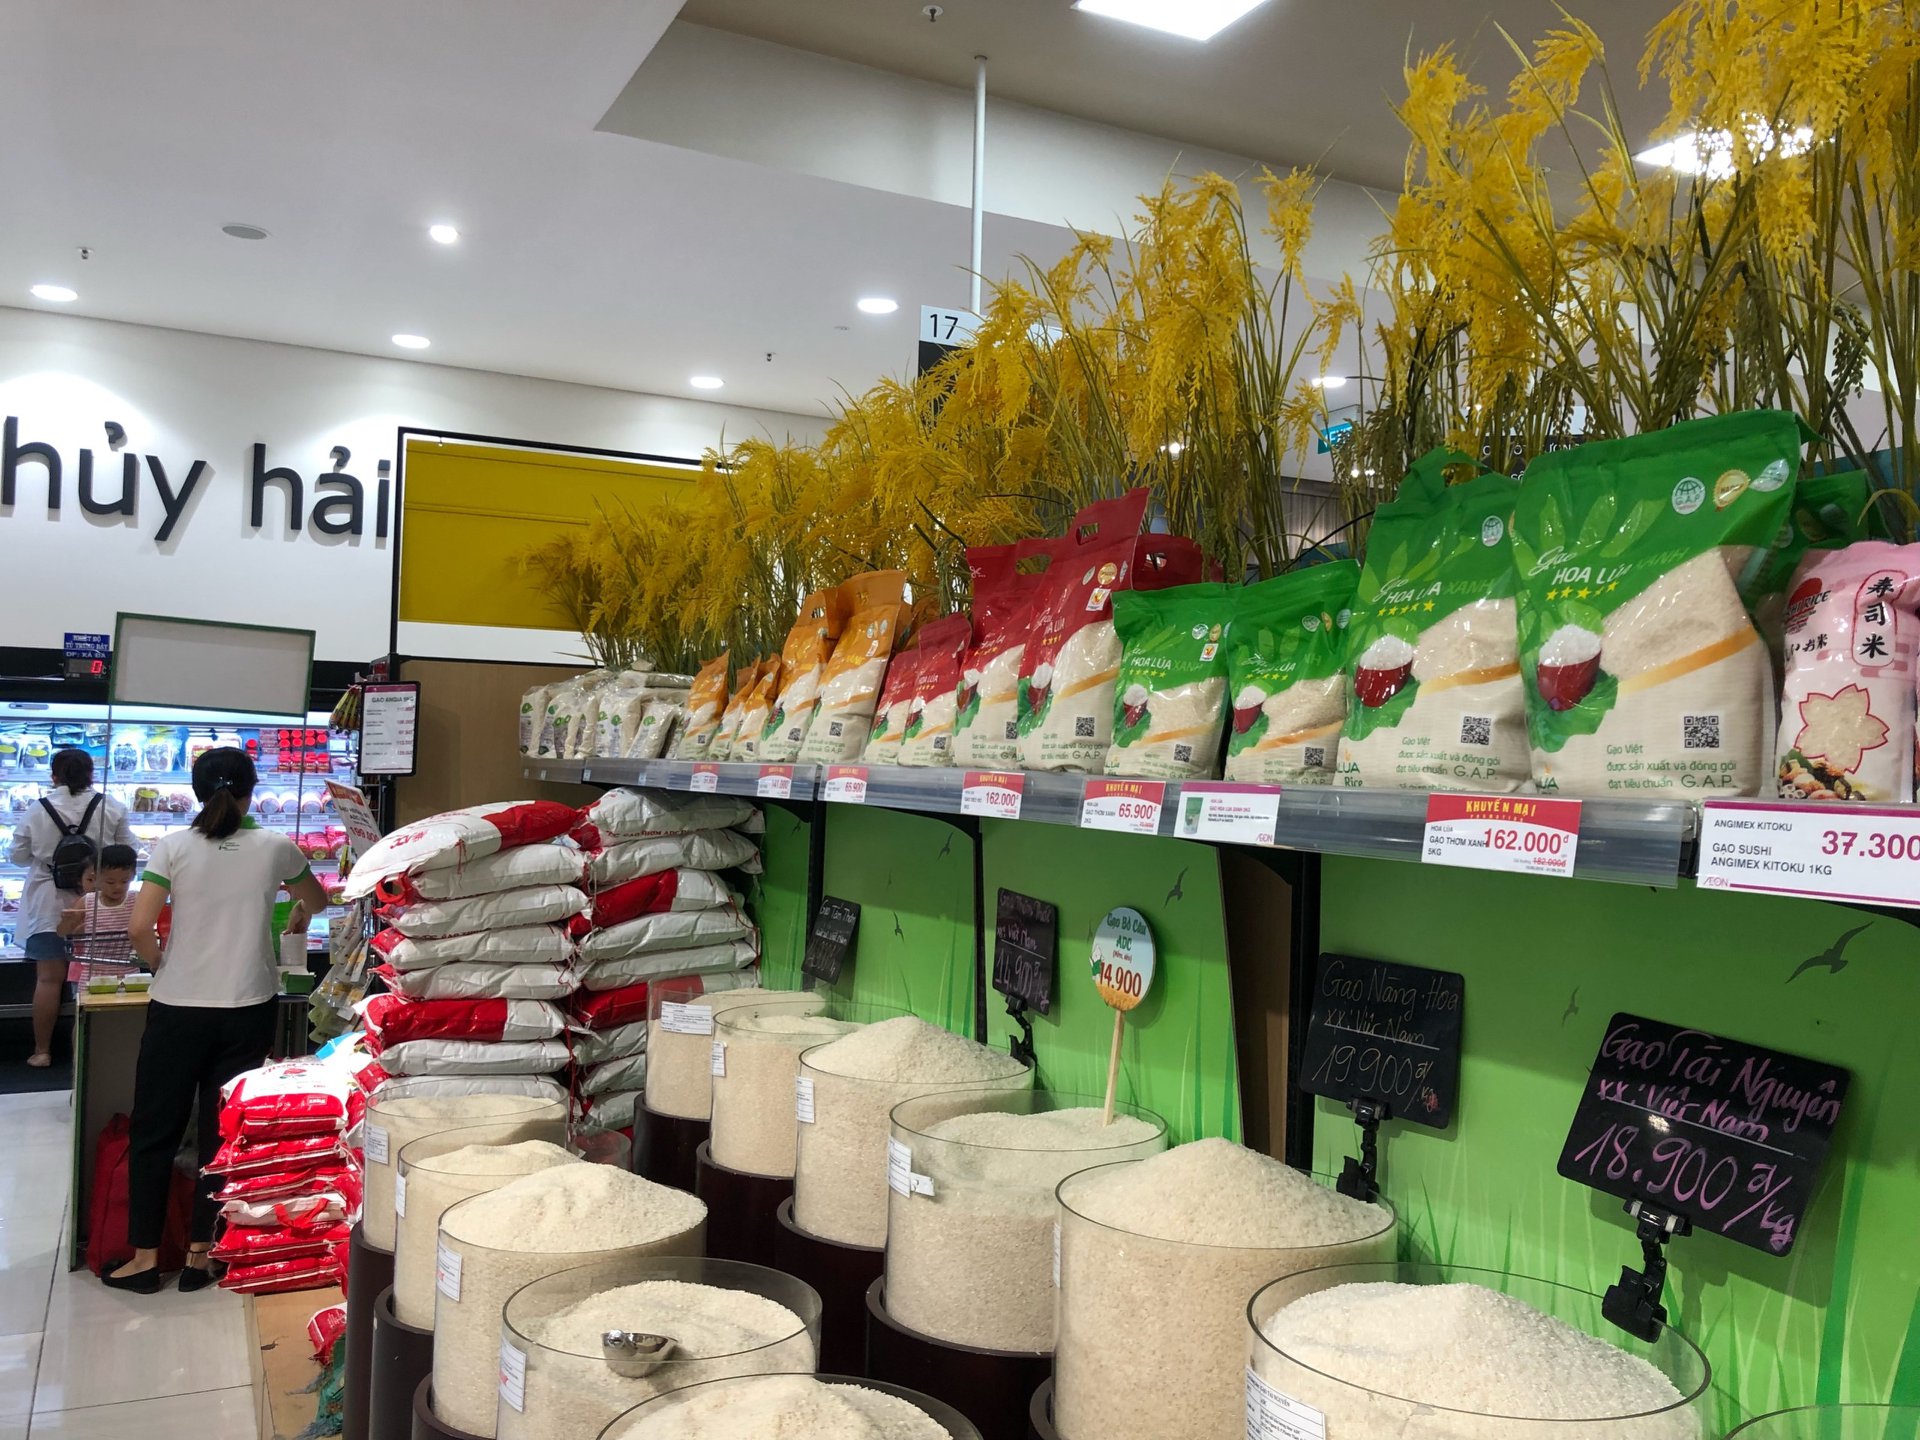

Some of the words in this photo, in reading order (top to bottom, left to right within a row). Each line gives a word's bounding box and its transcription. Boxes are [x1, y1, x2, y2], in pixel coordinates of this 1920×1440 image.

[929, 313, 959, 340] 17
[251, 442, 391, 538] hải
[1551, 566, 1592, 585] HOA
[1383, 590, 1415, 605] HOA
[1444, 577, 1495, 595] XANH
[1859, 576, 1895, 659] 寿司米
[1130, 657, 1151, 666] HOA
[1151, 656, 1172, 670] LÚA
[1625, 743, 1644, 755] Việt
[1450, 753, 1460, 762] và
[1461, 754, 1485, 767] đóng
[1486, 756, 1501, 768] gói
[1647, 758, 1671, 772] xuất
[1673, 760, 1687, 772] và
[1689, 759, 1718, 775] đóng
[1720, 760, 1737, 775] gói
[1680, 774, 1738, 789] G.A.P.
[1714, 819, 1756, 831] ANGIMEX
[1757, 821, 1793, 833] KITOKU
[1429, 835, 1446, 848] GẠO
[1446, 836, 1467, 847] THƠM
[1712, 842, 1737, 856] GẠO
[1738, 844, 1773, 857] SUSHI
[1427, 848, 1442, 857] 5KG
[1711, 857, 1760, 871] ANGIMEX
[1763, 860, 1806, 875] KITOKU
[1809, 865, 1833, 877] 1KG
[1116, 935, 1132, 951] ADC
[1100, 961, 1142, 998] 14.900
[1701, 1099, 1769, 1142] Nam
[1574, 1123, 1738, 1211] 18.900
